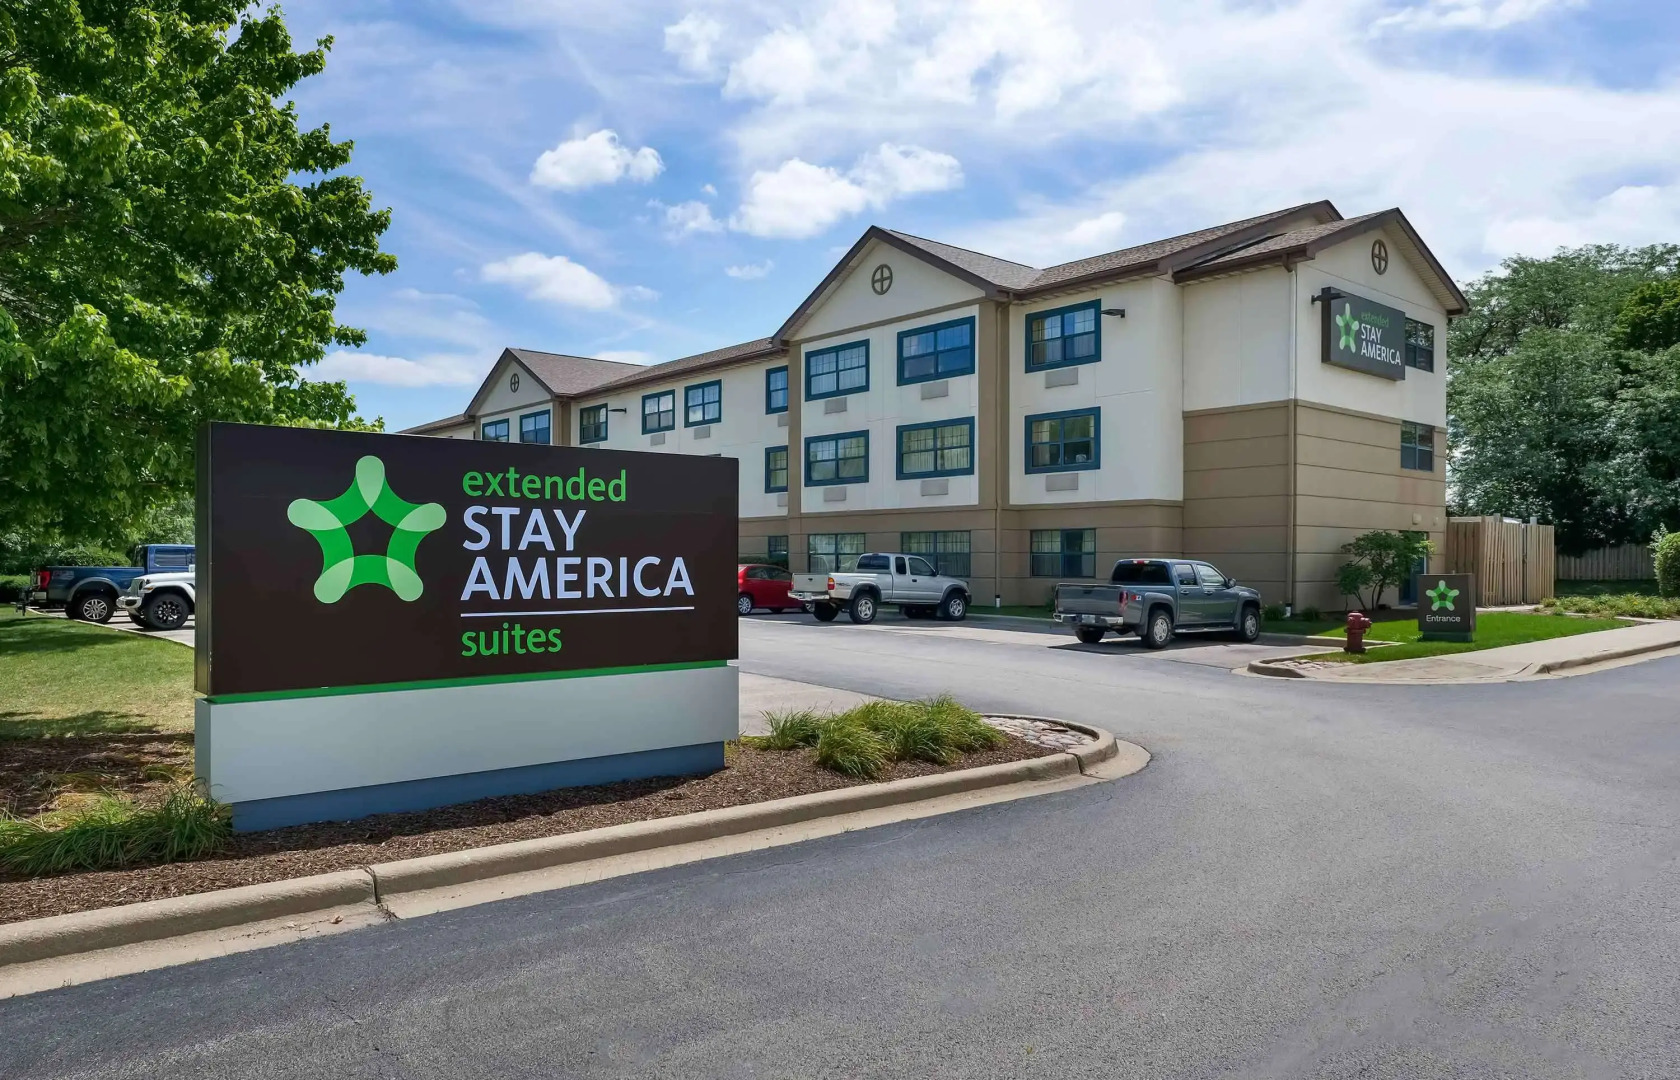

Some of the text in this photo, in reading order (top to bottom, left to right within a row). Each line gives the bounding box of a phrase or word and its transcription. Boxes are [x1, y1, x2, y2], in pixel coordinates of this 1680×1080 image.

[1361, 312, 1390, 328] extended
[1361, 324, 1382, 343] STAY
[1361, 341, 1401, 366] AMERICA
[461, 466, 627, 502] extended
[462, 505, 587, 551] STAY
[460, 556, 695, 601] AMERICA
[1426, 614, 1461, 623] Entrance
[461, 621, 563, 657] suites
